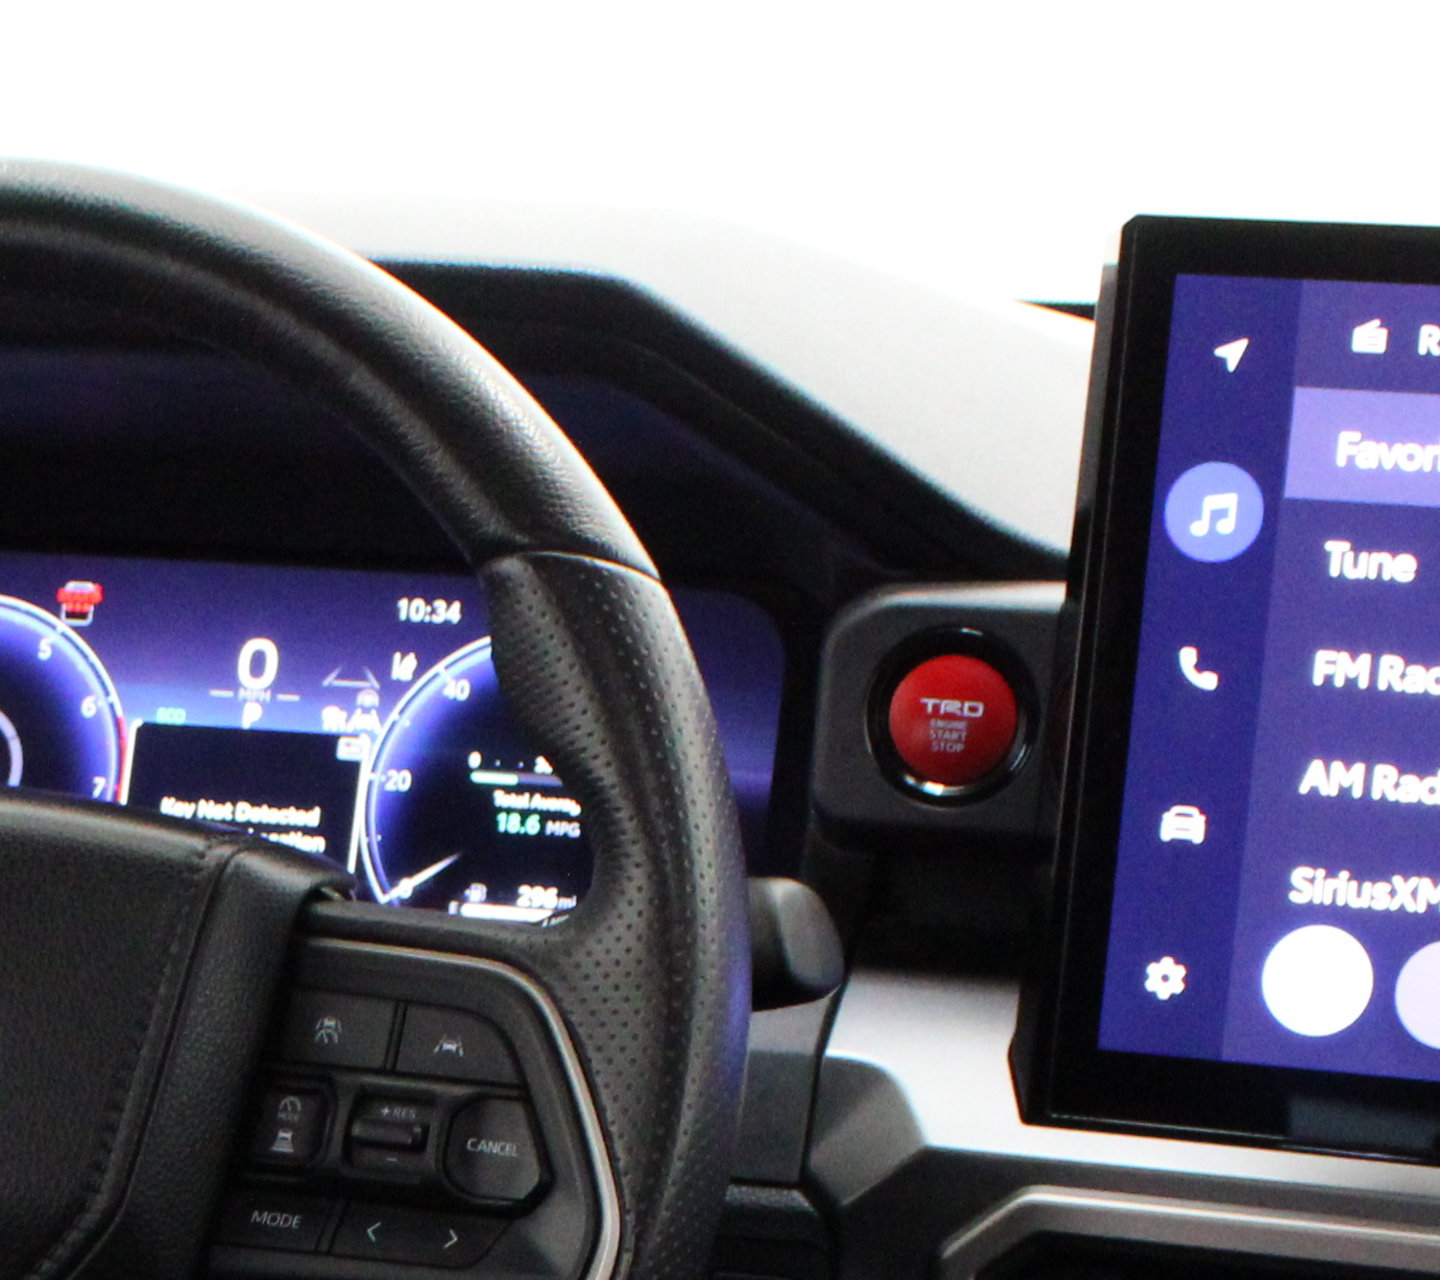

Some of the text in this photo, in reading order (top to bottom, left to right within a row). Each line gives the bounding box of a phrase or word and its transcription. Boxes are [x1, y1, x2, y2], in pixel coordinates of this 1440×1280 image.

[1324, 540, 1418, 583] Tune
[397, 597, 462, 624] 10:34
[237, 637, 279, 690] 0
[1312, 650, 1371, 690] FM
[443, 679, 470, 701] 40
[921, 698, 984, 718] TRD
[929, 729, 966, 741] START
[931, 741, 964, 753] STOP
[384, 770, 412, 792] 20
[1299, 760, 1364, 799] AM
[496, 812, 581, 838] 18.6 MPG
[466, 1137, 519, 1157] CANCEL
[251, 1210, 303, 1230] MODE
